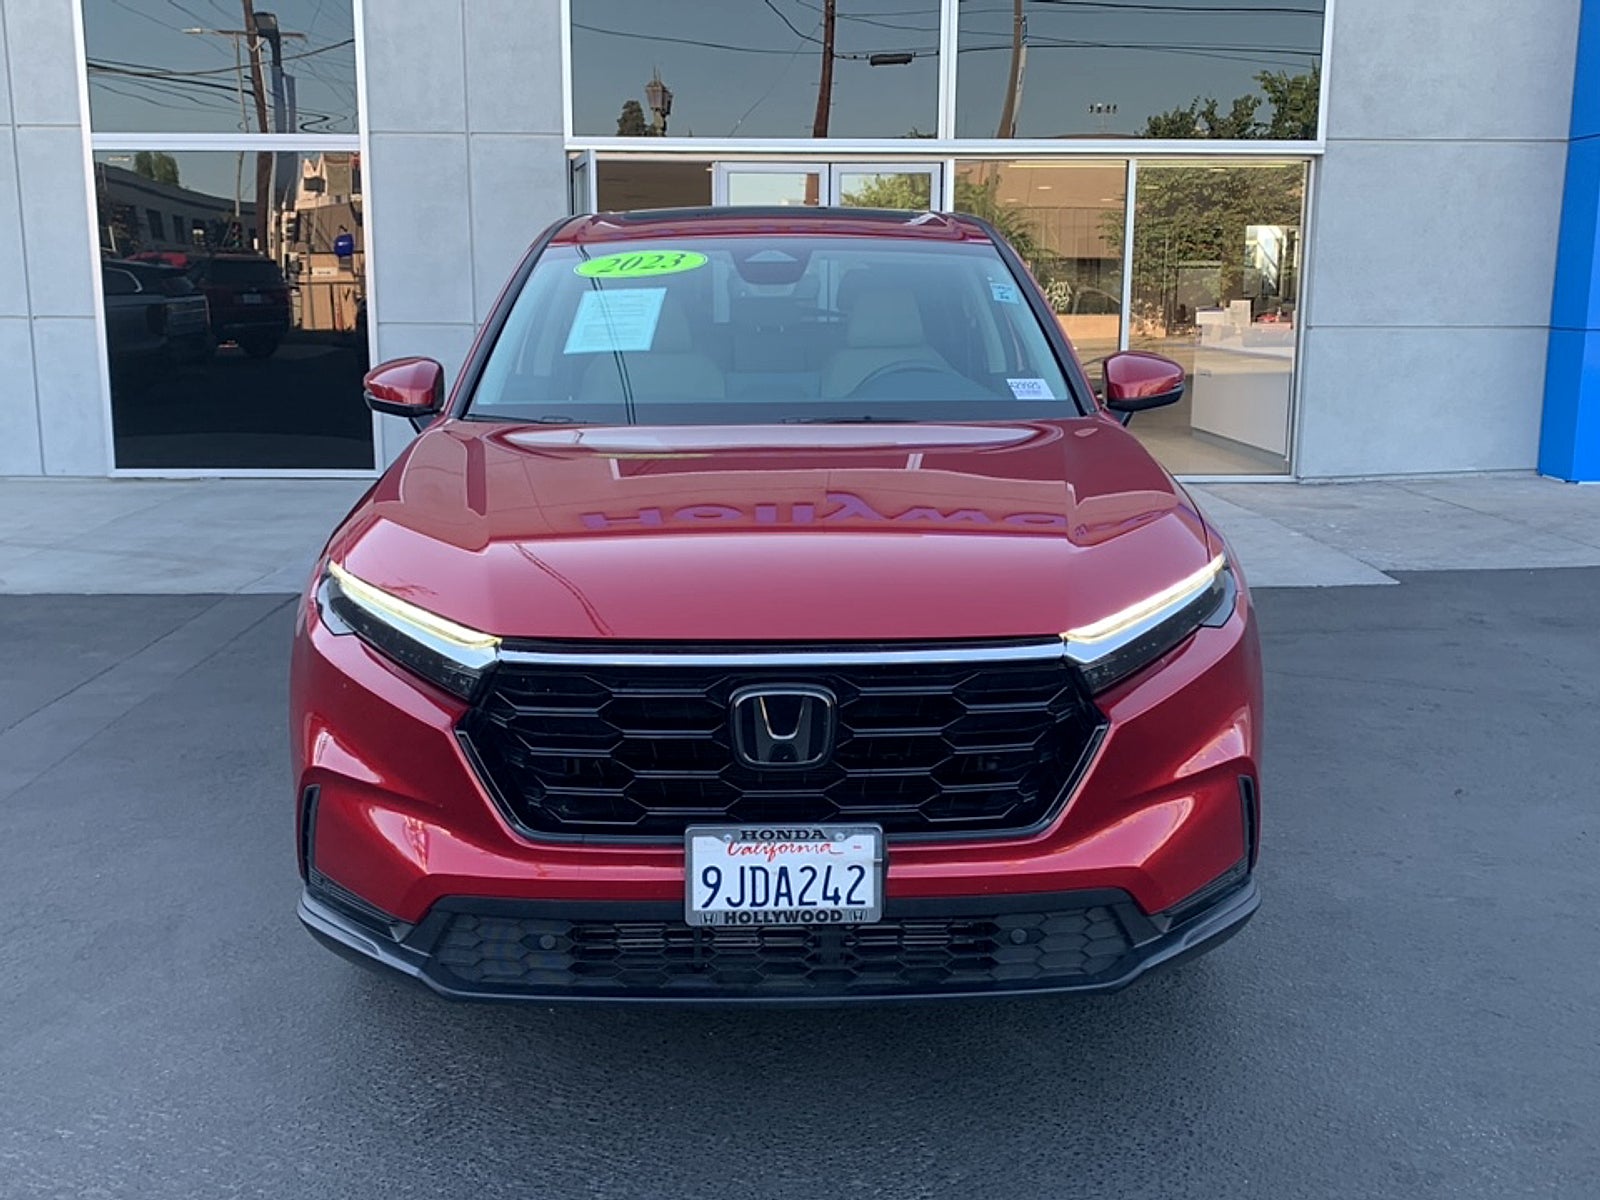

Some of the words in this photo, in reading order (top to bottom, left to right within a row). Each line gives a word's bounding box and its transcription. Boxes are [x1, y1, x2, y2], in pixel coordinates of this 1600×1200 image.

[597, 253, 687, 273] 2023
[740, 829, 828, 841] HONDA
[727, 842, 844, 863] California
[701, 864, 867, 909] 9JDA242
[724, 909, 844, 925] HOLLYWOOD
